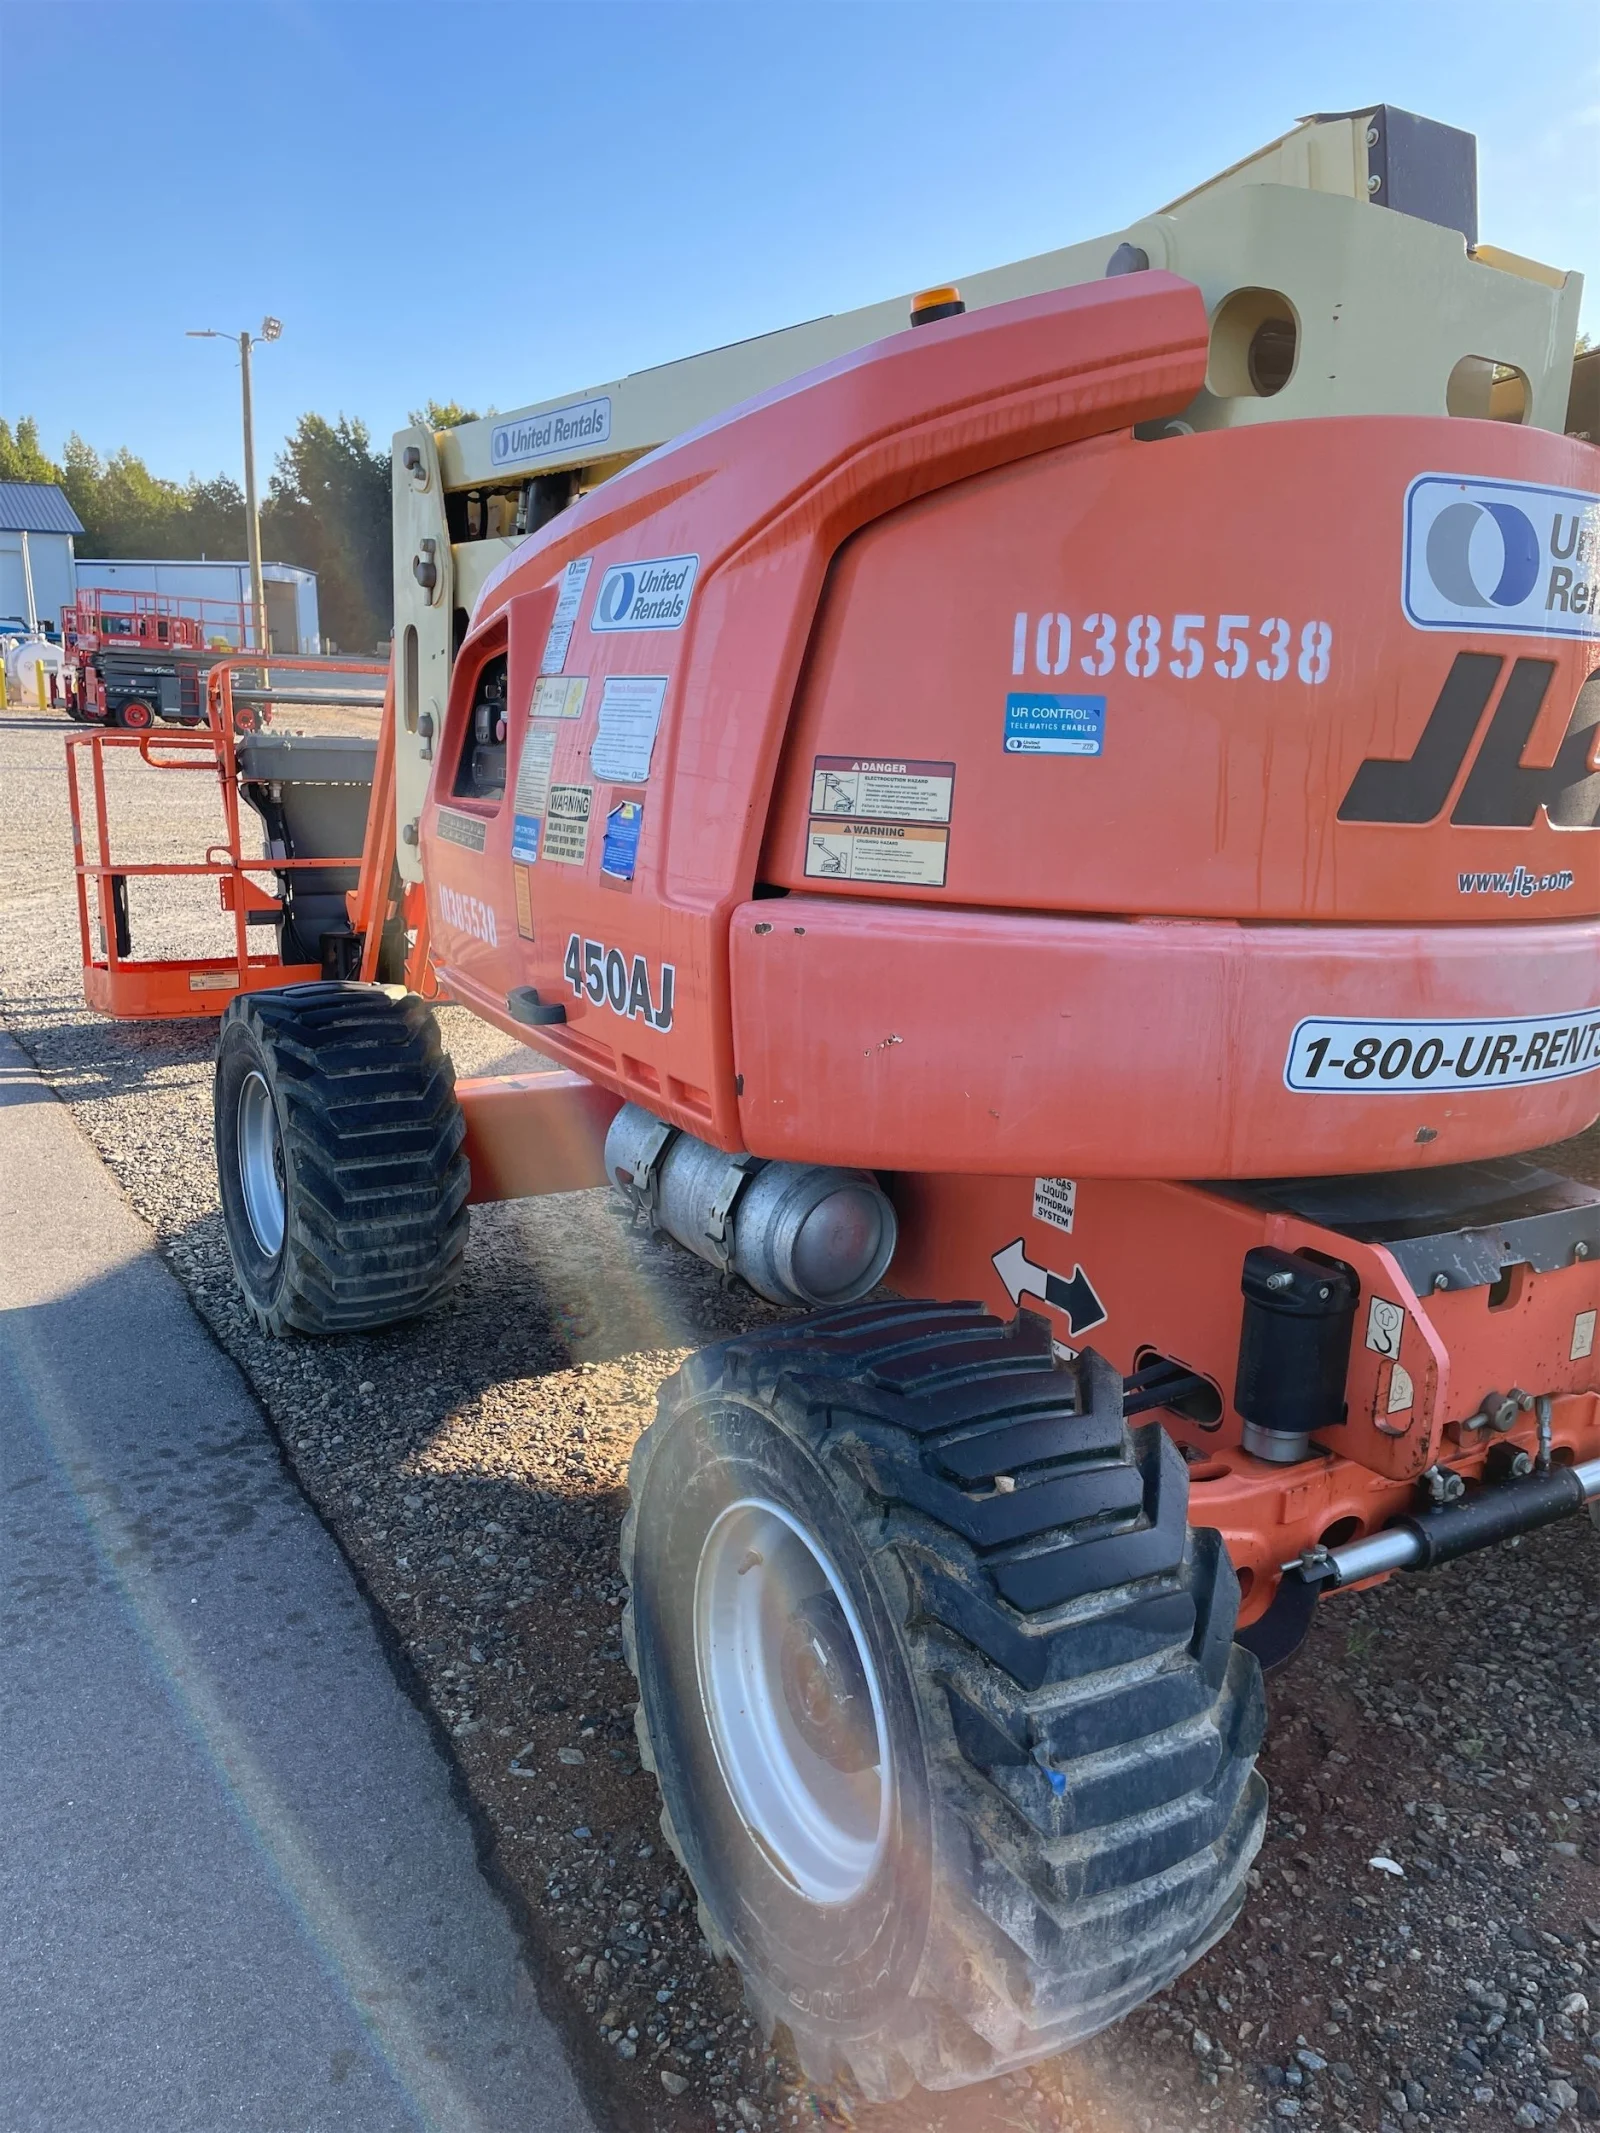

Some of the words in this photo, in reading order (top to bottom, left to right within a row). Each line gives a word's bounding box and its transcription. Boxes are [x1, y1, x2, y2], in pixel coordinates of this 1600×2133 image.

[511, 421, 552, 453] United
[554, 408, 603, 443] Rentals
[638, 565, 689, 593] United
[629, 594, 684, 620] Rentals
[1011, 611, 1334, 685] 10385538
[1011, 707, 1029, 718] UR
[1032, 708, 1089, 720] CONTROL
[1010, 722, 1058, 730] TELEMATICS
[1061, 723, 1097, 732] ENABLED
[861, 762, 907, 773] DANGER
[551, 794, 589, 814] WARNING
[853, 825, 905, 837] WARNING
[1458, 866, 1574, 898] www.jlg.com
[564, 933, 676, 1033] 450AJ
[1042, 1183, 1069, 1202] LIQUID
[1055, 1177, 1072, 1191] GAS
[1035, 1192, 1074, 1217] WITHDRAW
[1037, 1206, 1069, 1228] SYSTEM
